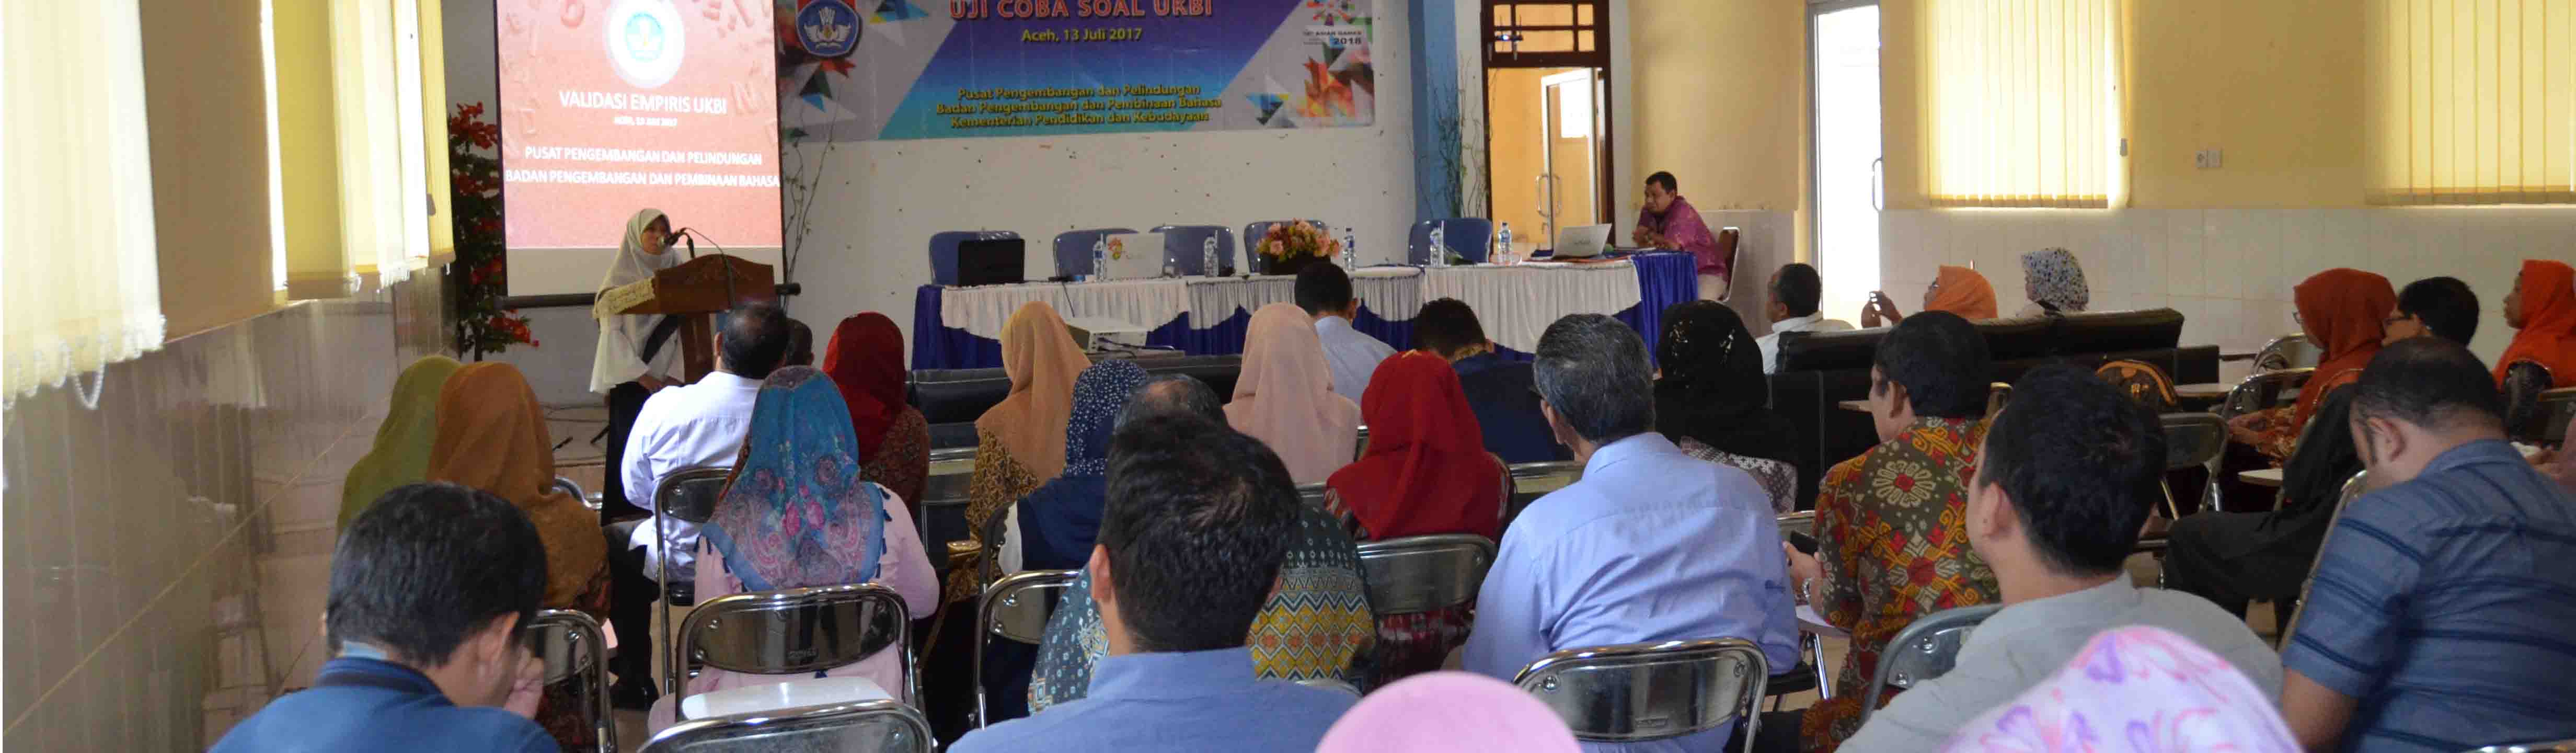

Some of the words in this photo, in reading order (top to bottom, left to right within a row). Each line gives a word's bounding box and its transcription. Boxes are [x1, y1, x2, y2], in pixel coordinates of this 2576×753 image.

[949, 0, 988, 18] UJI
[997, 0, 1070, 18] COBA
[1078, 0, 1145, 17] SOAL
[1153, 0, 1213, 17] UKBI
[1021, 29, 1060, 42] Aceh,
[1064, 29, 1079, 41] 13
[1083, 28, 1106, 41] Juli
[1110, 28, 1142, 40] 2017
[559, 92, 627, 110] VALIDASI
[631, 94, 691, 113] EMPIRIS
[693, 97, 727, 115] UKBI
[525, 146, 562, 159] PUSAT
[565, 147, 660, 163] PENGEMBANGAN
[661, 150, 685, 163] DAN
[687, 151, 762, 165] PELINDUNGAN
[505, 170, 548, 182] BADAN
[549, 171, 647, 185] PENGEMBANGAN
[649, 173, 673, 185] DAN
[675, 173, 738, 186] PEMBINAAN
[739, 175, 780, 187] BAHASA
